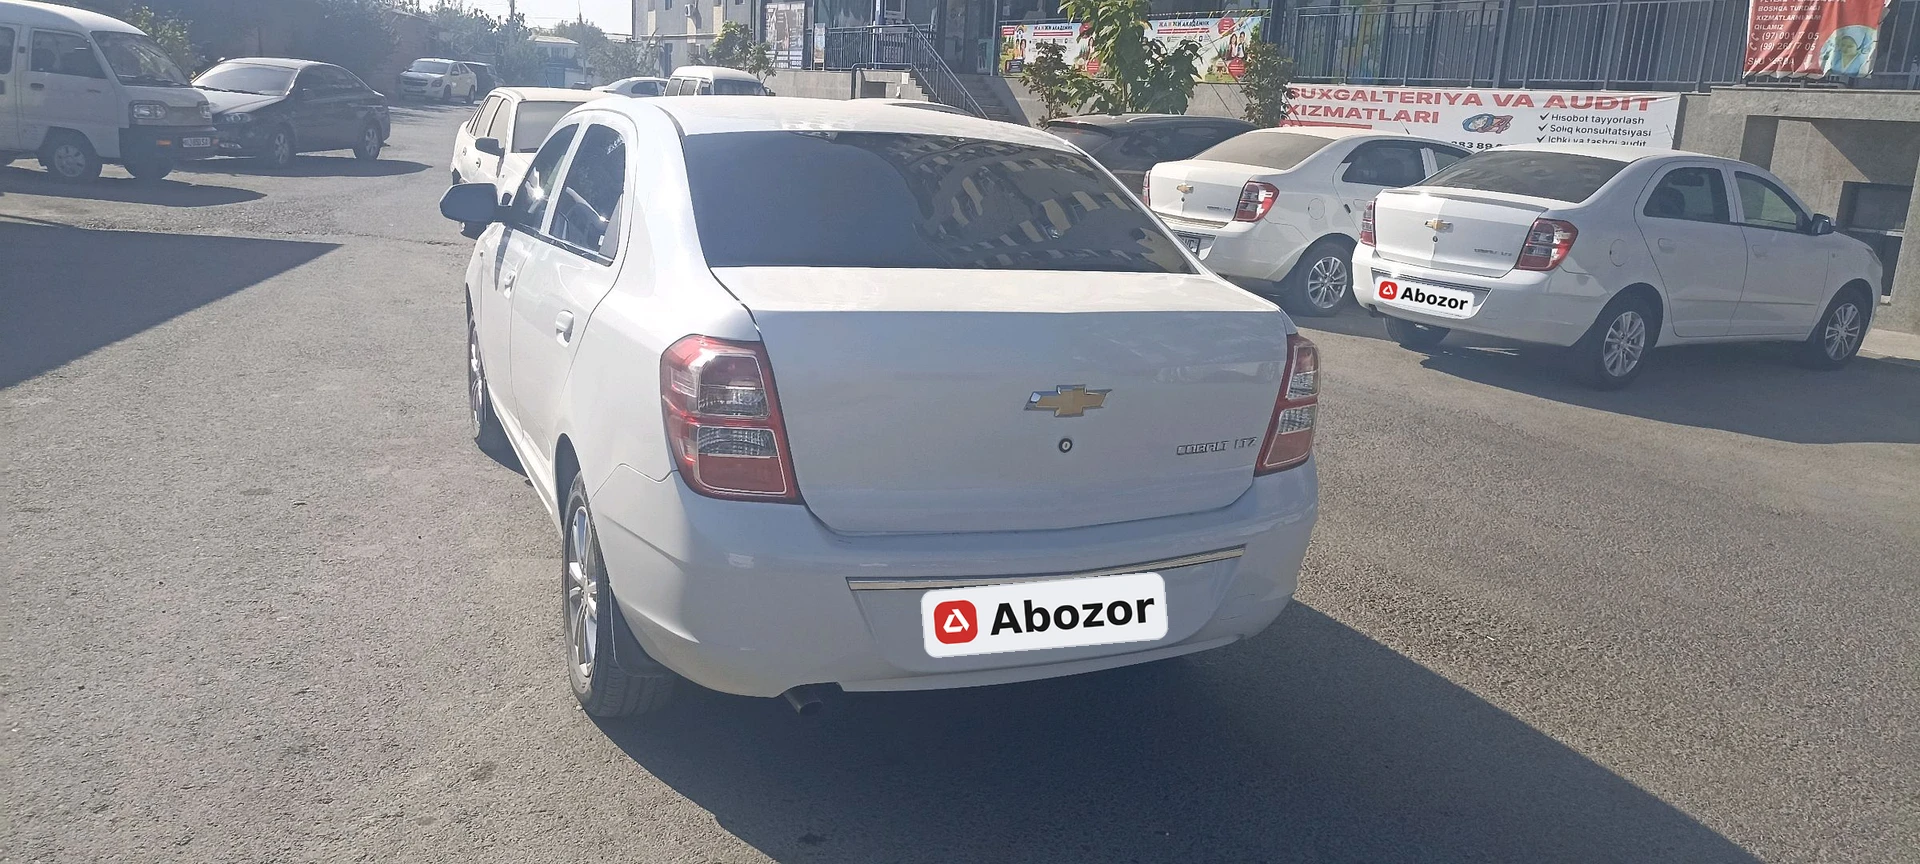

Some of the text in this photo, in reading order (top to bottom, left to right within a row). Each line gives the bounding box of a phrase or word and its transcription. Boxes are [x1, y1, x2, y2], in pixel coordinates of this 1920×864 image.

[1492, 93, 1534, 108] VA
[1543, 94, 1657, 111] AUDIT
[1286, 103, 1439, 124] XIZMATLARI
[1551, 113, 1645, 126] Hisobot tayyorlash
[1550, 124, 1573, 135] Soliq
[1177, 441, 1229, 456] COBALT
